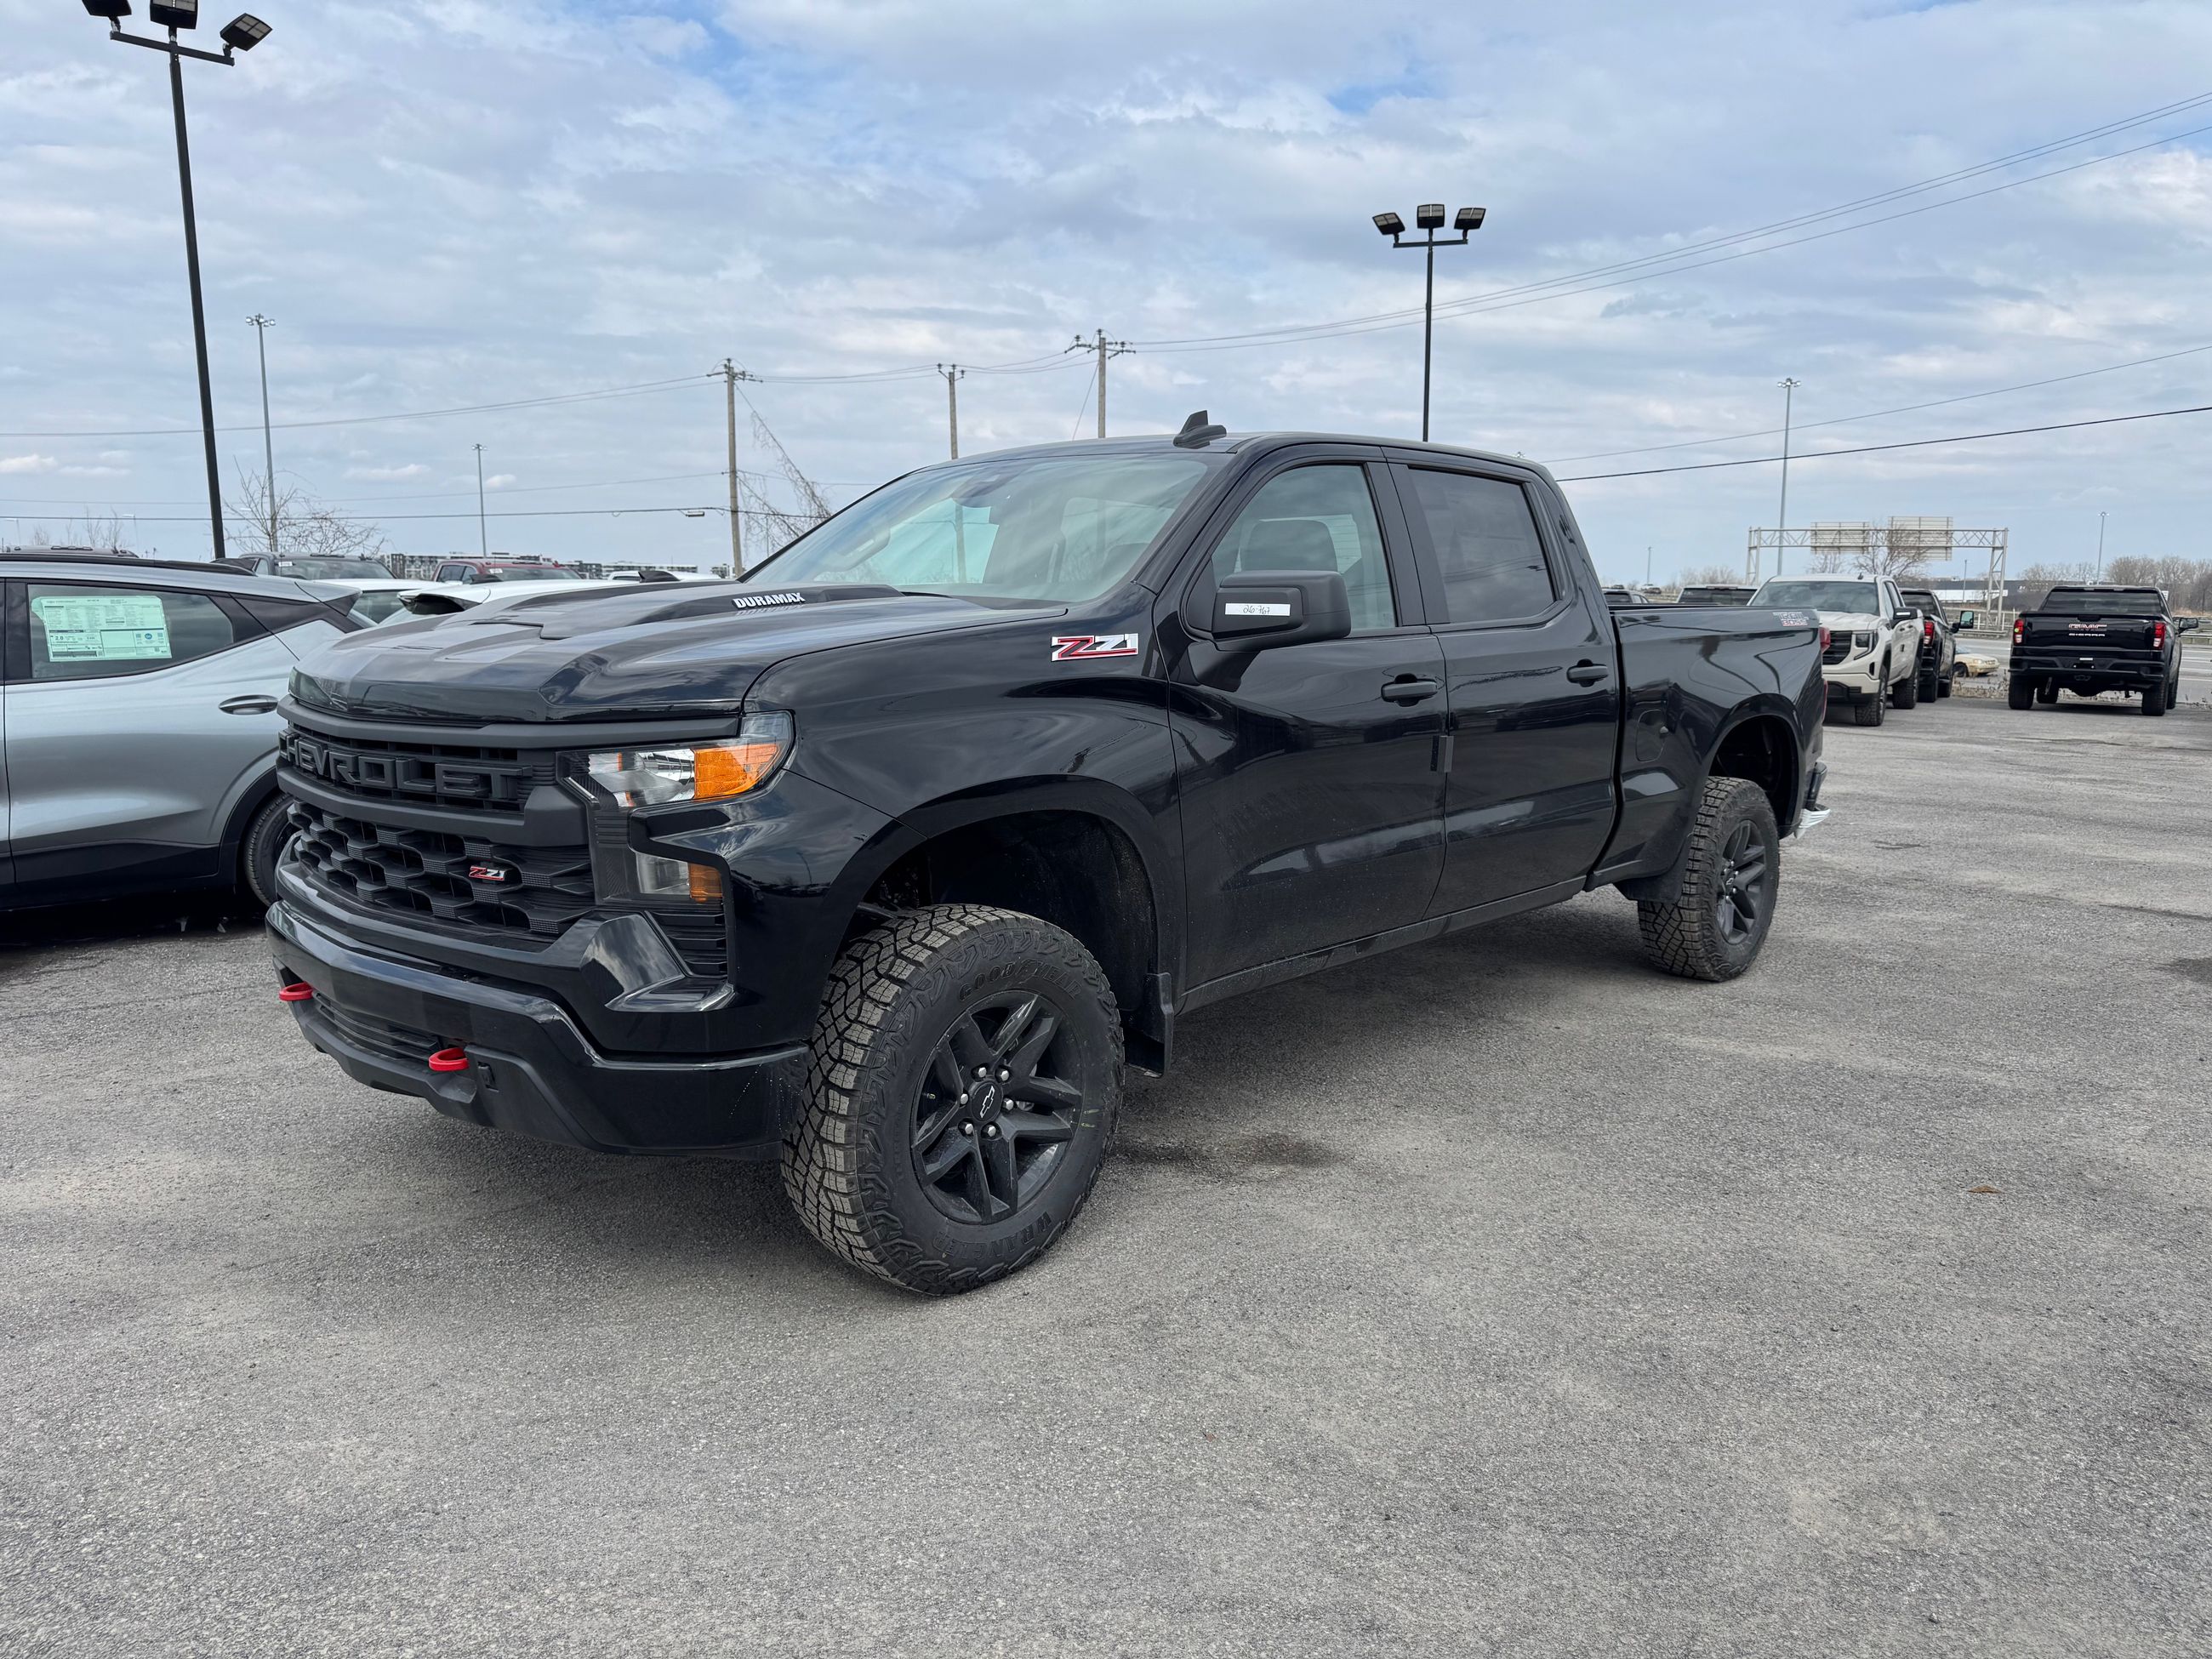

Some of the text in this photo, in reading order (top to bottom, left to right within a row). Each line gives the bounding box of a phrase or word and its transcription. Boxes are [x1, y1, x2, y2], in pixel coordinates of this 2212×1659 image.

[733, 592, 806, 608] DURAMAX
[1052, 633, 1138, 661] Z71
[278, 731, 531, 801] CHEVROLET
[959, 959, 1083, 1001] GOODYEAR
